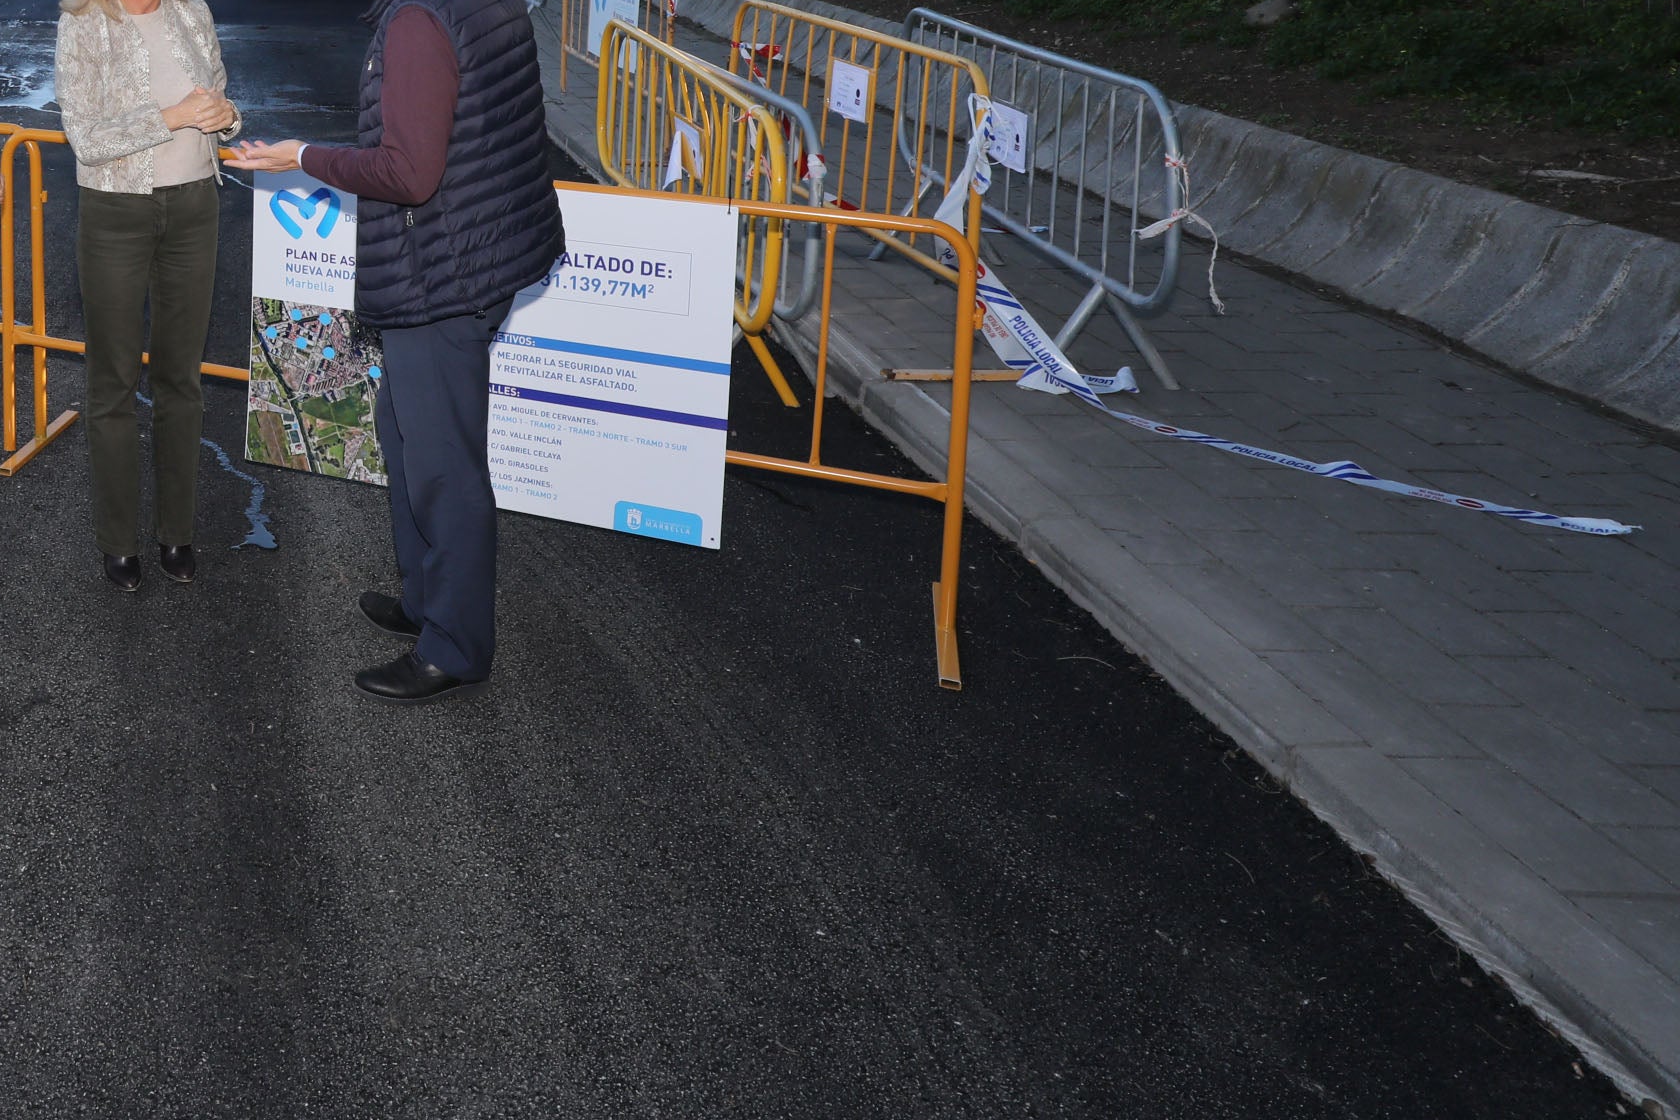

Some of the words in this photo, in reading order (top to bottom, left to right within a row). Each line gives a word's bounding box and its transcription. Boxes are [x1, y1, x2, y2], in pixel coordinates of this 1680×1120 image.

[286, 248, 317, 261] PLAN
[321, 253, 336, 264] DE
[340, 255, 355, 266] AS
[559, 252, 634, 274] ALTADO
[641, 261, 672, 279] DE:
[286, 263, 323, 276] NUEVA
[326, 268, 357, 281] ANDA
[286, 277, 334, 292] Marbella
[1010, 314, 1041, 350] POLICIA
[1034, 347, 1064, 375] LOCAL
[498, 351, 541, 364] MEJORAR
[544, 358, 556, 367] LA
[558, 360, 613, 375] SEGURIDAD
[616, 369, 637, 379] VIAL
[496, 363, 502, 372] Y
[504, 365, 563, 380] REVITALIZAR
[566, 374, 577, 383] EL
[579, 377, 637, 392] ASFALTADO.
[488, 383, 520, 397] ALLES:
[493, 404, 509, 412] AVD.
[511, 406, 539, 417] MIGUEL
[541, 410, 550, 418] DE
[552, 411, 598, 426] CERVANTES:
[491, 429, 508, 437] AVD.
[509, 431, 532, 441] VALLE
[534, 433, 562, 446] INCLÁN
[492, 414, 517, 424] TRAMO
[530, 420, 556, 430] TRAMO
[569, 426, 595, 437] TRAMO
[603, 431, 629, 442] NORTE
[636, 437, 663, 448] TRAMO
[670, 442, 688, 452] SUR
[490, 442, 499, 450] C/
[500, 444, 531, 456] GABRIEL
[533, 449, 562, 460] CELAYA
[1231, 445, 1277, 461] POLICIA
[1279, 458, 1317, 472] LOCAL
[490, 457, 506, 465] AVD.
[508, 460, 549, 472] GIRASOLES
[499, 473, 512, 481] LOS
[514, 475, 553, 488] JAZMINES:
[526, 488, 552, 499] TRAMO
